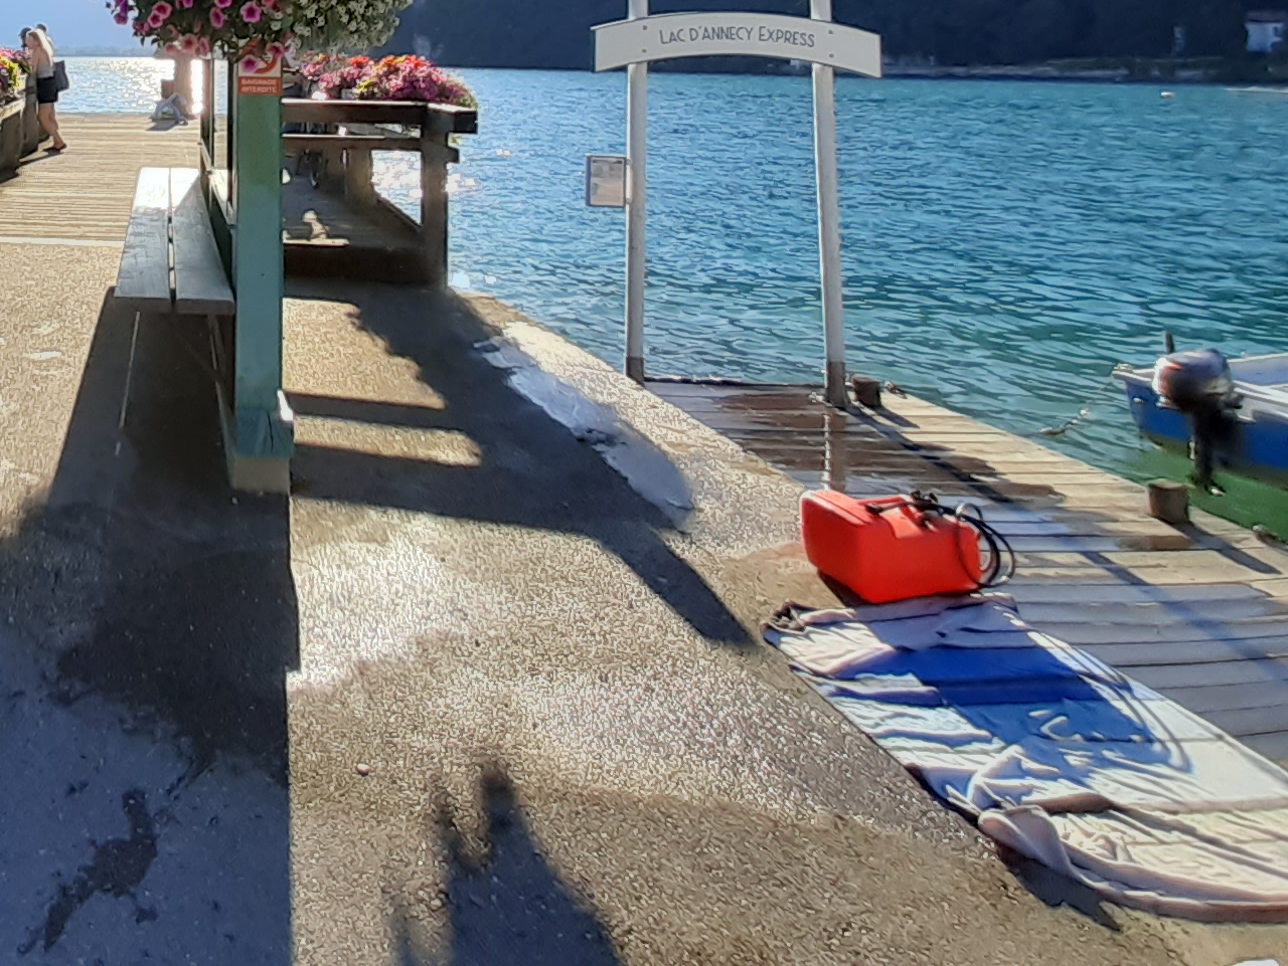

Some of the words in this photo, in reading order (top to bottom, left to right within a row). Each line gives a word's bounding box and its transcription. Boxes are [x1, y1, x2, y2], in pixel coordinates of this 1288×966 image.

[659, 28, 685, 45] LAC
[689, 25, 754, 42] D'ANNECY
[758, 25, 816, 48] EXPRESS
